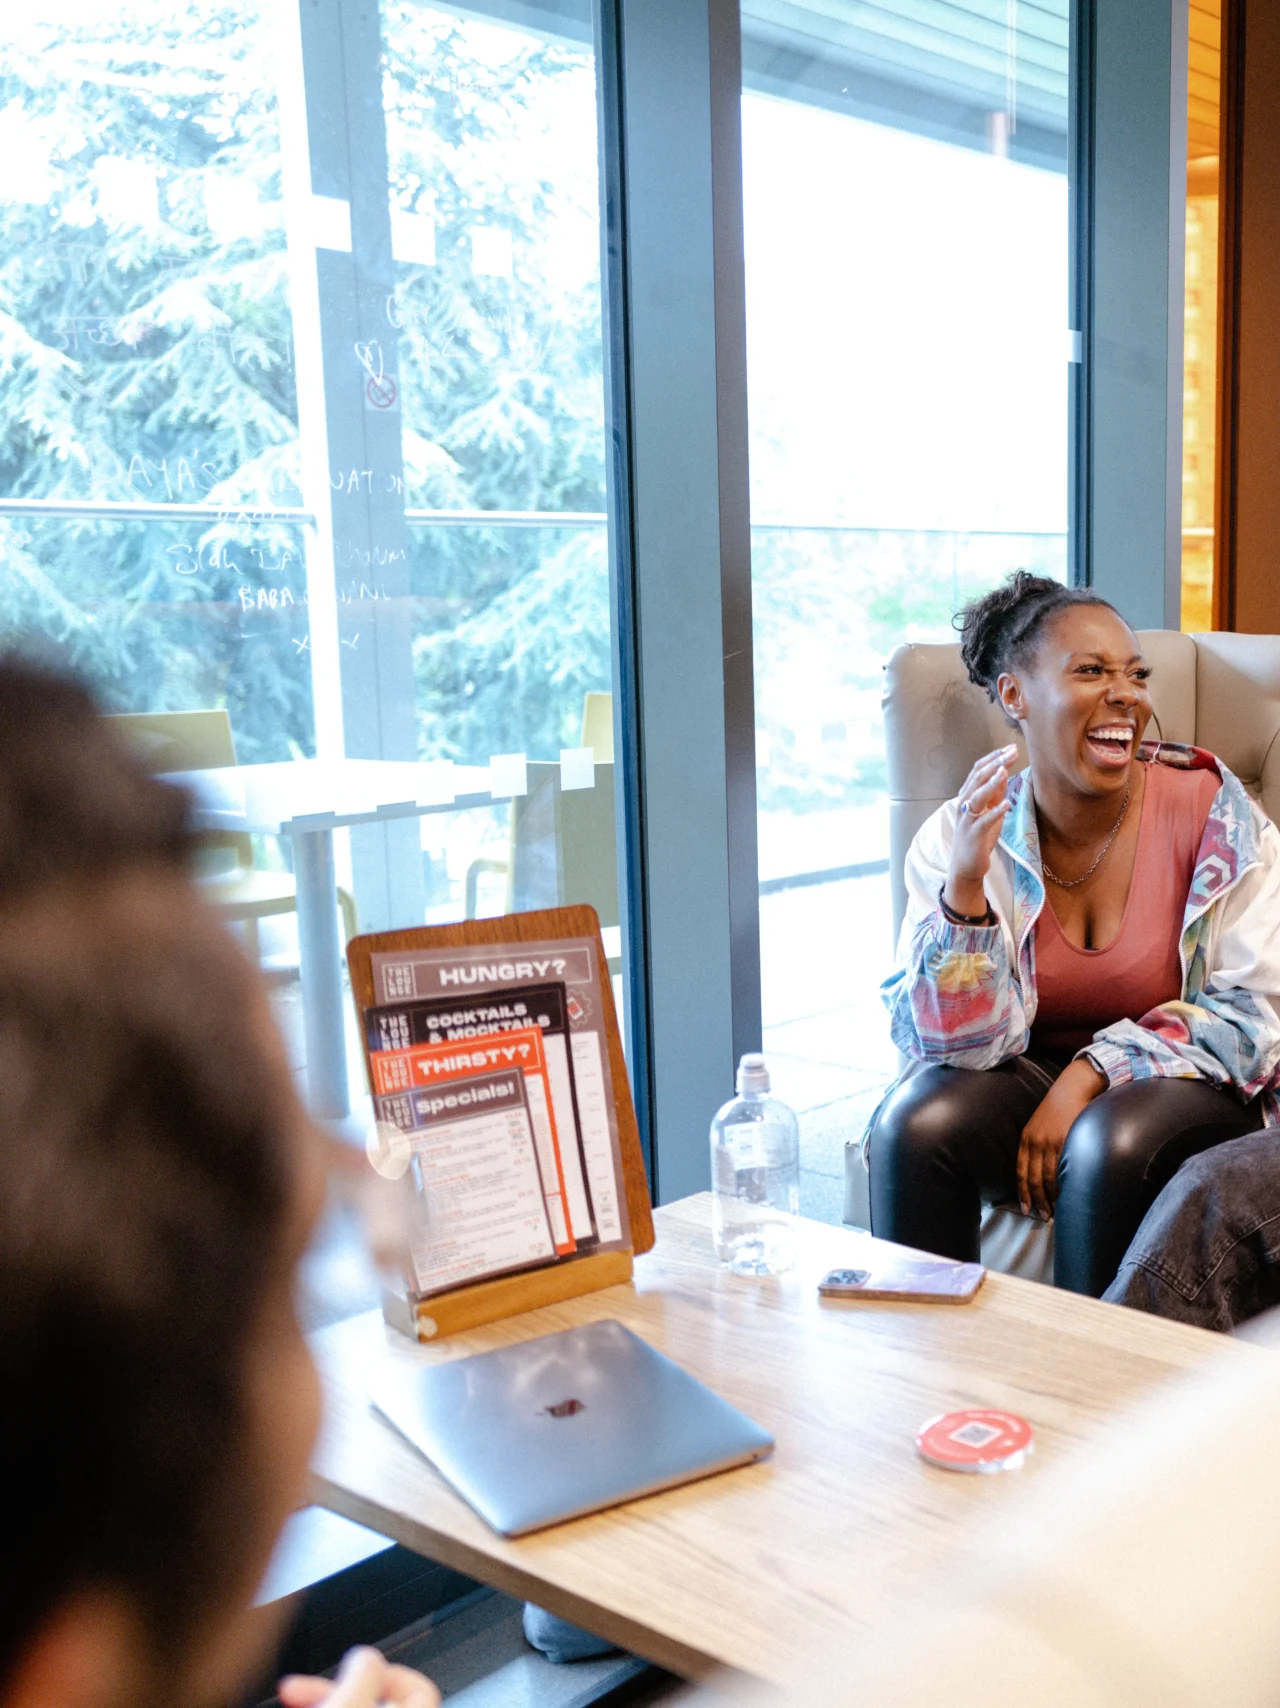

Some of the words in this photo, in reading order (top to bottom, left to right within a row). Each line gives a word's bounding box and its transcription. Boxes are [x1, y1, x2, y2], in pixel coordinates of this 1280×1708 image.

[439, 959, 567, 986] HUNGRY?
[379, 1014, 408, 1029] THE
[426, 1002, 528, 1030] COCKTAILS
[428, 1031, 443, 1045] &
[446, 1014, 551, 1041] MOCKTAILS
[417, 1043, 531, 1075] THIRSTY?
